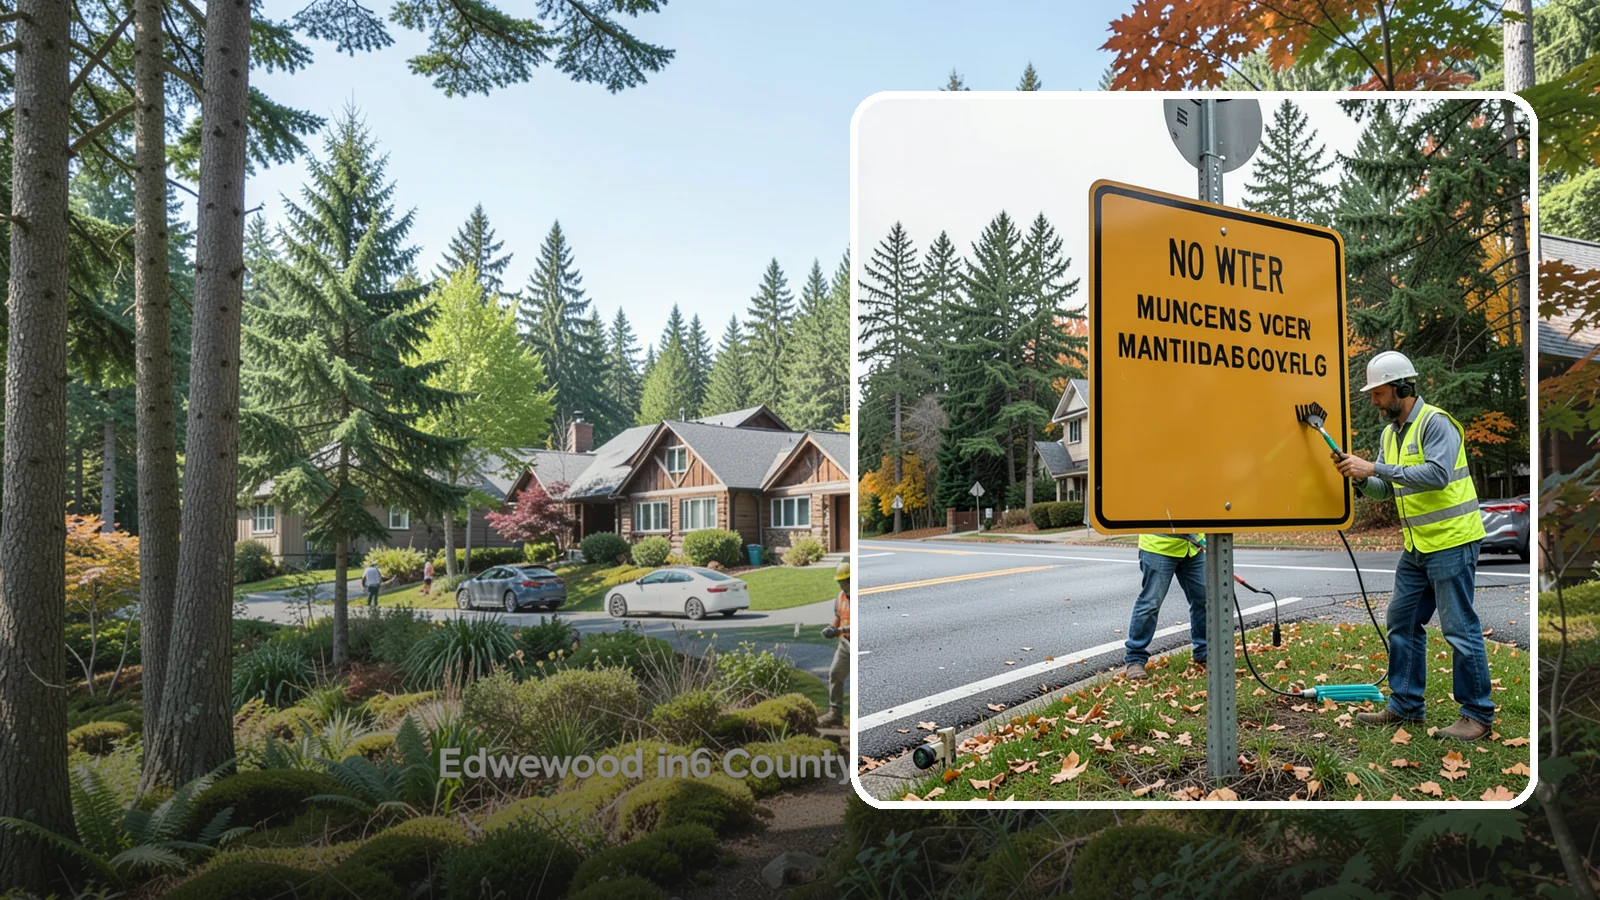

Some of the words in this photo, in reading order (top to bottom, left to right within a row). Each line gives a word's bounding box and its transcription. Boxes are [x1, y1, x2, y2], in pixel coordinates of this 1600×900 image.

[1169, 237, 1205, 281] NO
[1215, 244, 1284, 294] WTER
[1137, 293, 1251, 333] MUNCENS
